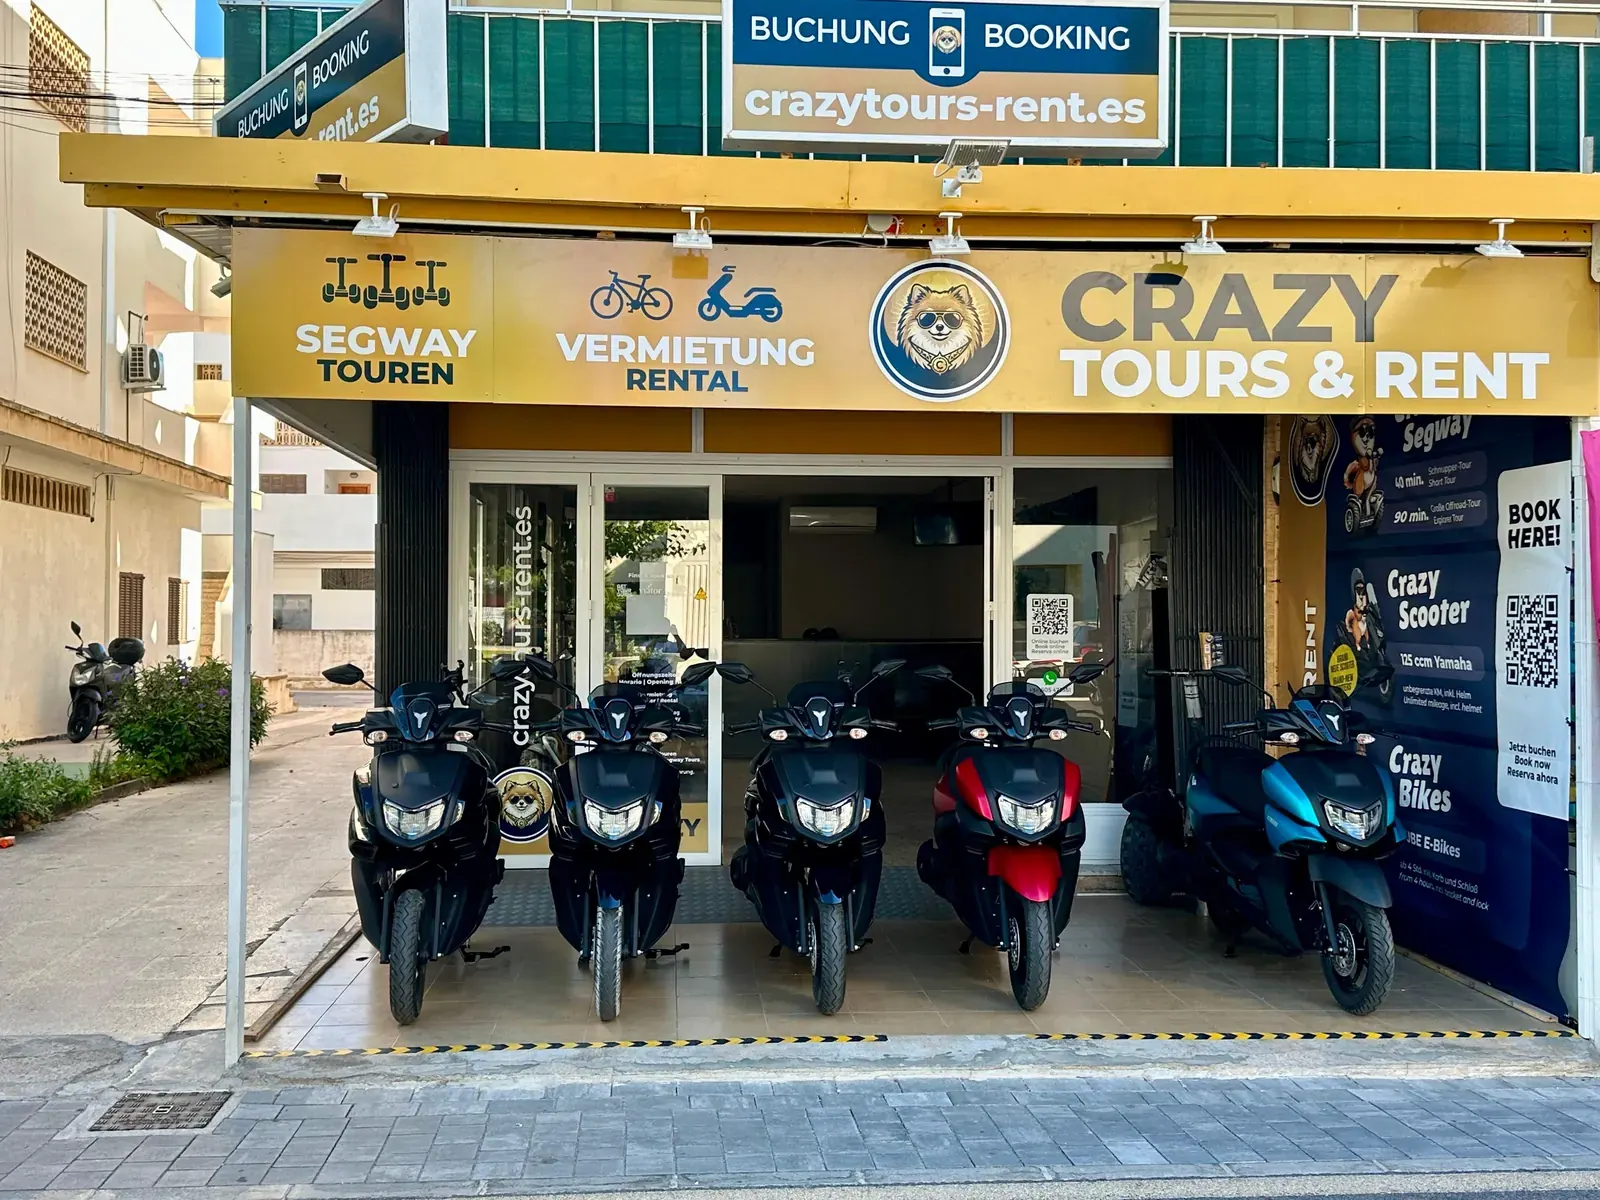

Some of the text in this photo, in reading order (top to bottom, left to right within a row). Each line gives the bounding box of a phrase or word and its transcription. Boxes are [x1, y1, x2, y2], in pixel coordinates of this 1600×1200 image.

[750, 15, 1131, 51] BUCHUNG BOOKING
[238, 29, 370, 138] BUCHUNG BOOKING
[744, 88, 1147, 127] crazytours-rent.es
[1061, 270, 1399, 343] CRAZY
[296, 324, 477, 358] SEGWAY
[556, 333, 815, 366] VERMIETUNG
[317, 359, 454, 385] TOUREN
[626, 368, 749, 393] RENTAL
[1060, 349, 1550, 400] TOURS & RENT
[1403, 415, 1472, 452] Segway
[1395, 472, 1424, 489] 40 min.
[1428, 476, 1456, 488] Short Tour
[1394, 507, 1429, 523] 90 min.
[1452, 513, 1464, 522] Tour
[1508, 498, 1561, 525] BOOK
[1508, 524, 1561, 549] HERE!
[1387, 568, 1440, 599] Crazy
[1399, 600, 1470, 630] Scooter
[1303, 600, 1317, 687] RENT
[1400, 653, 1473, 671] 125 ccm Yamaha
[1456, 689, 1471, 700] Helm
[1462, 702, 1482, 714] helmet
[1508, 741, 1556, 758] Jetzt buchen
[1514, 755, 1551, 770] Book now
[1389, 745, 1442, 783] Crazy
[1507, 766, 1558, 785] Reserva ahora
[1399, 779, 1451, 812] Bikes
[1424, 835, 1461, 858] E-Bikes
